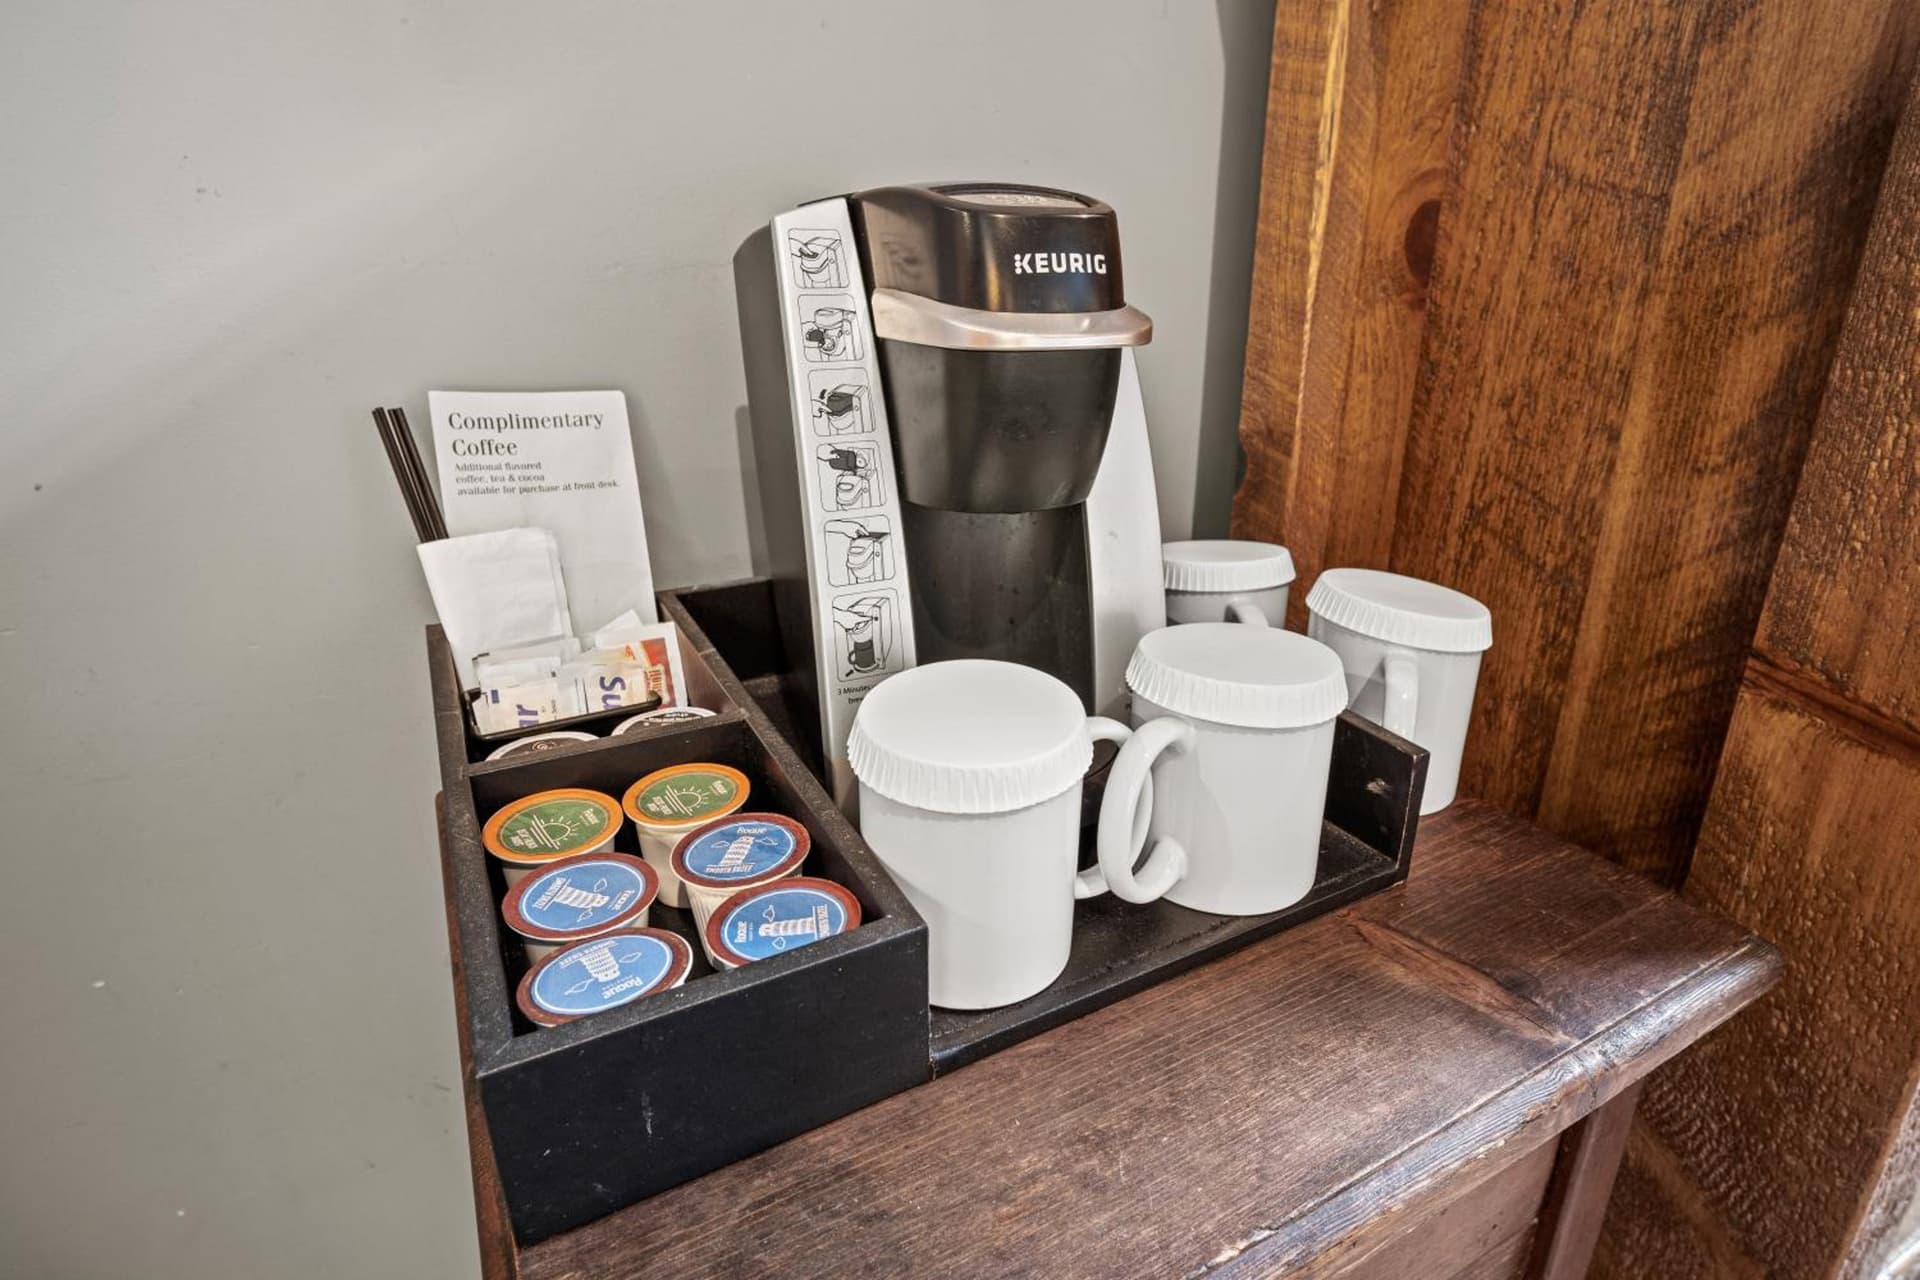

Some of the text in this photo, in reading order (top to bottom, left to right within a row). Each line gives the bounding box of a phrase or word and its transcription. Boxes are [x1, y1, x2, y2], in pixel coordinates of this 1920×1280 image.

[1014, 252, 1107, 275] KEURIG
[448, 411, 604, 434] Complimentary
[452, 438, 518, 457] Coffee
[455, 461, 542, 472] Additional flavored
[508, 474, 515, 482] &
[518, 474, 544, 482] cocoa
[457, 486, 500, 496] available
[503, 485, 516, 494] for
[518, 484, 560, 496] purchase
[562, 483, 572, 491] at
[574, 481, 595, 490] front
